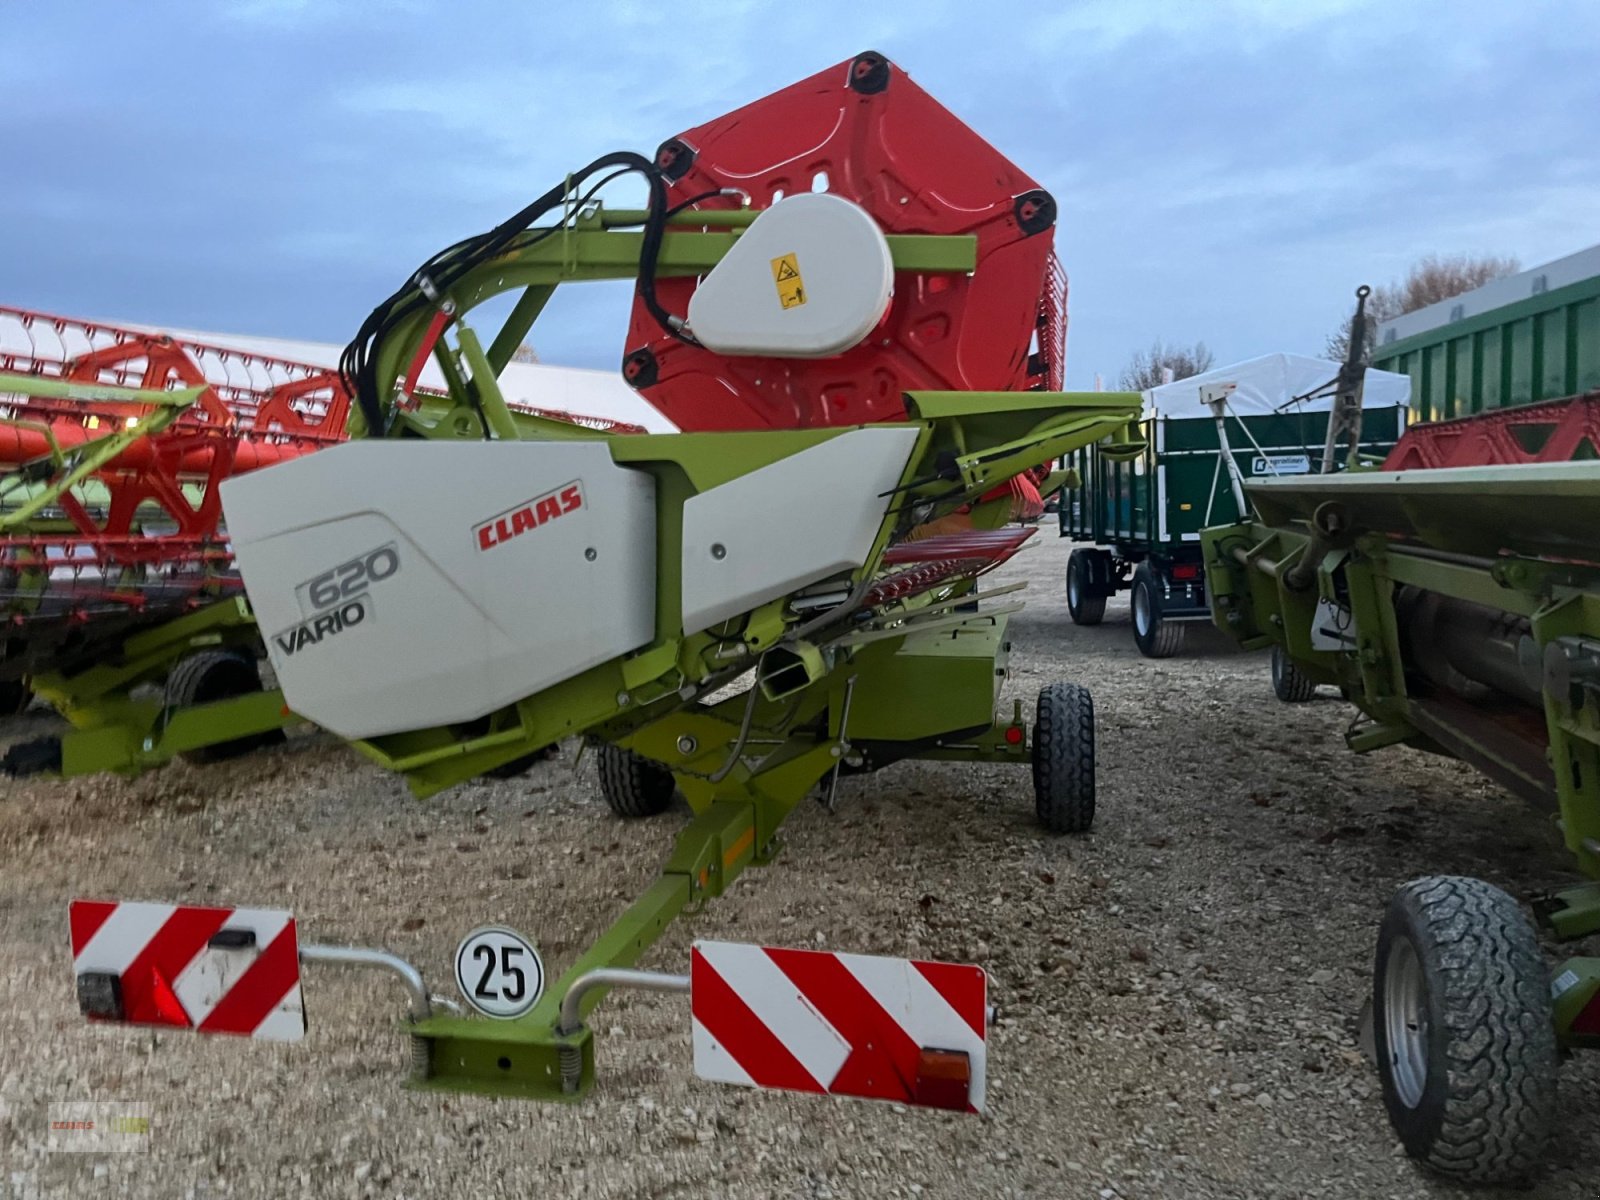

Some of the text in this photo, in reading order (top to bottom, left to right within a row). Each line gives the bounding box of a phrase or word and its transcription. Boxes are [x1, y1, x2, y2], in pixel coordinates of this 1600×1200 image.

[478, 485, 582, 551] CLAAS
[309, 548, 399, 610] 620
[276, 602, 365, 657] VARIO
[474, 945, 525, 1002] 25
